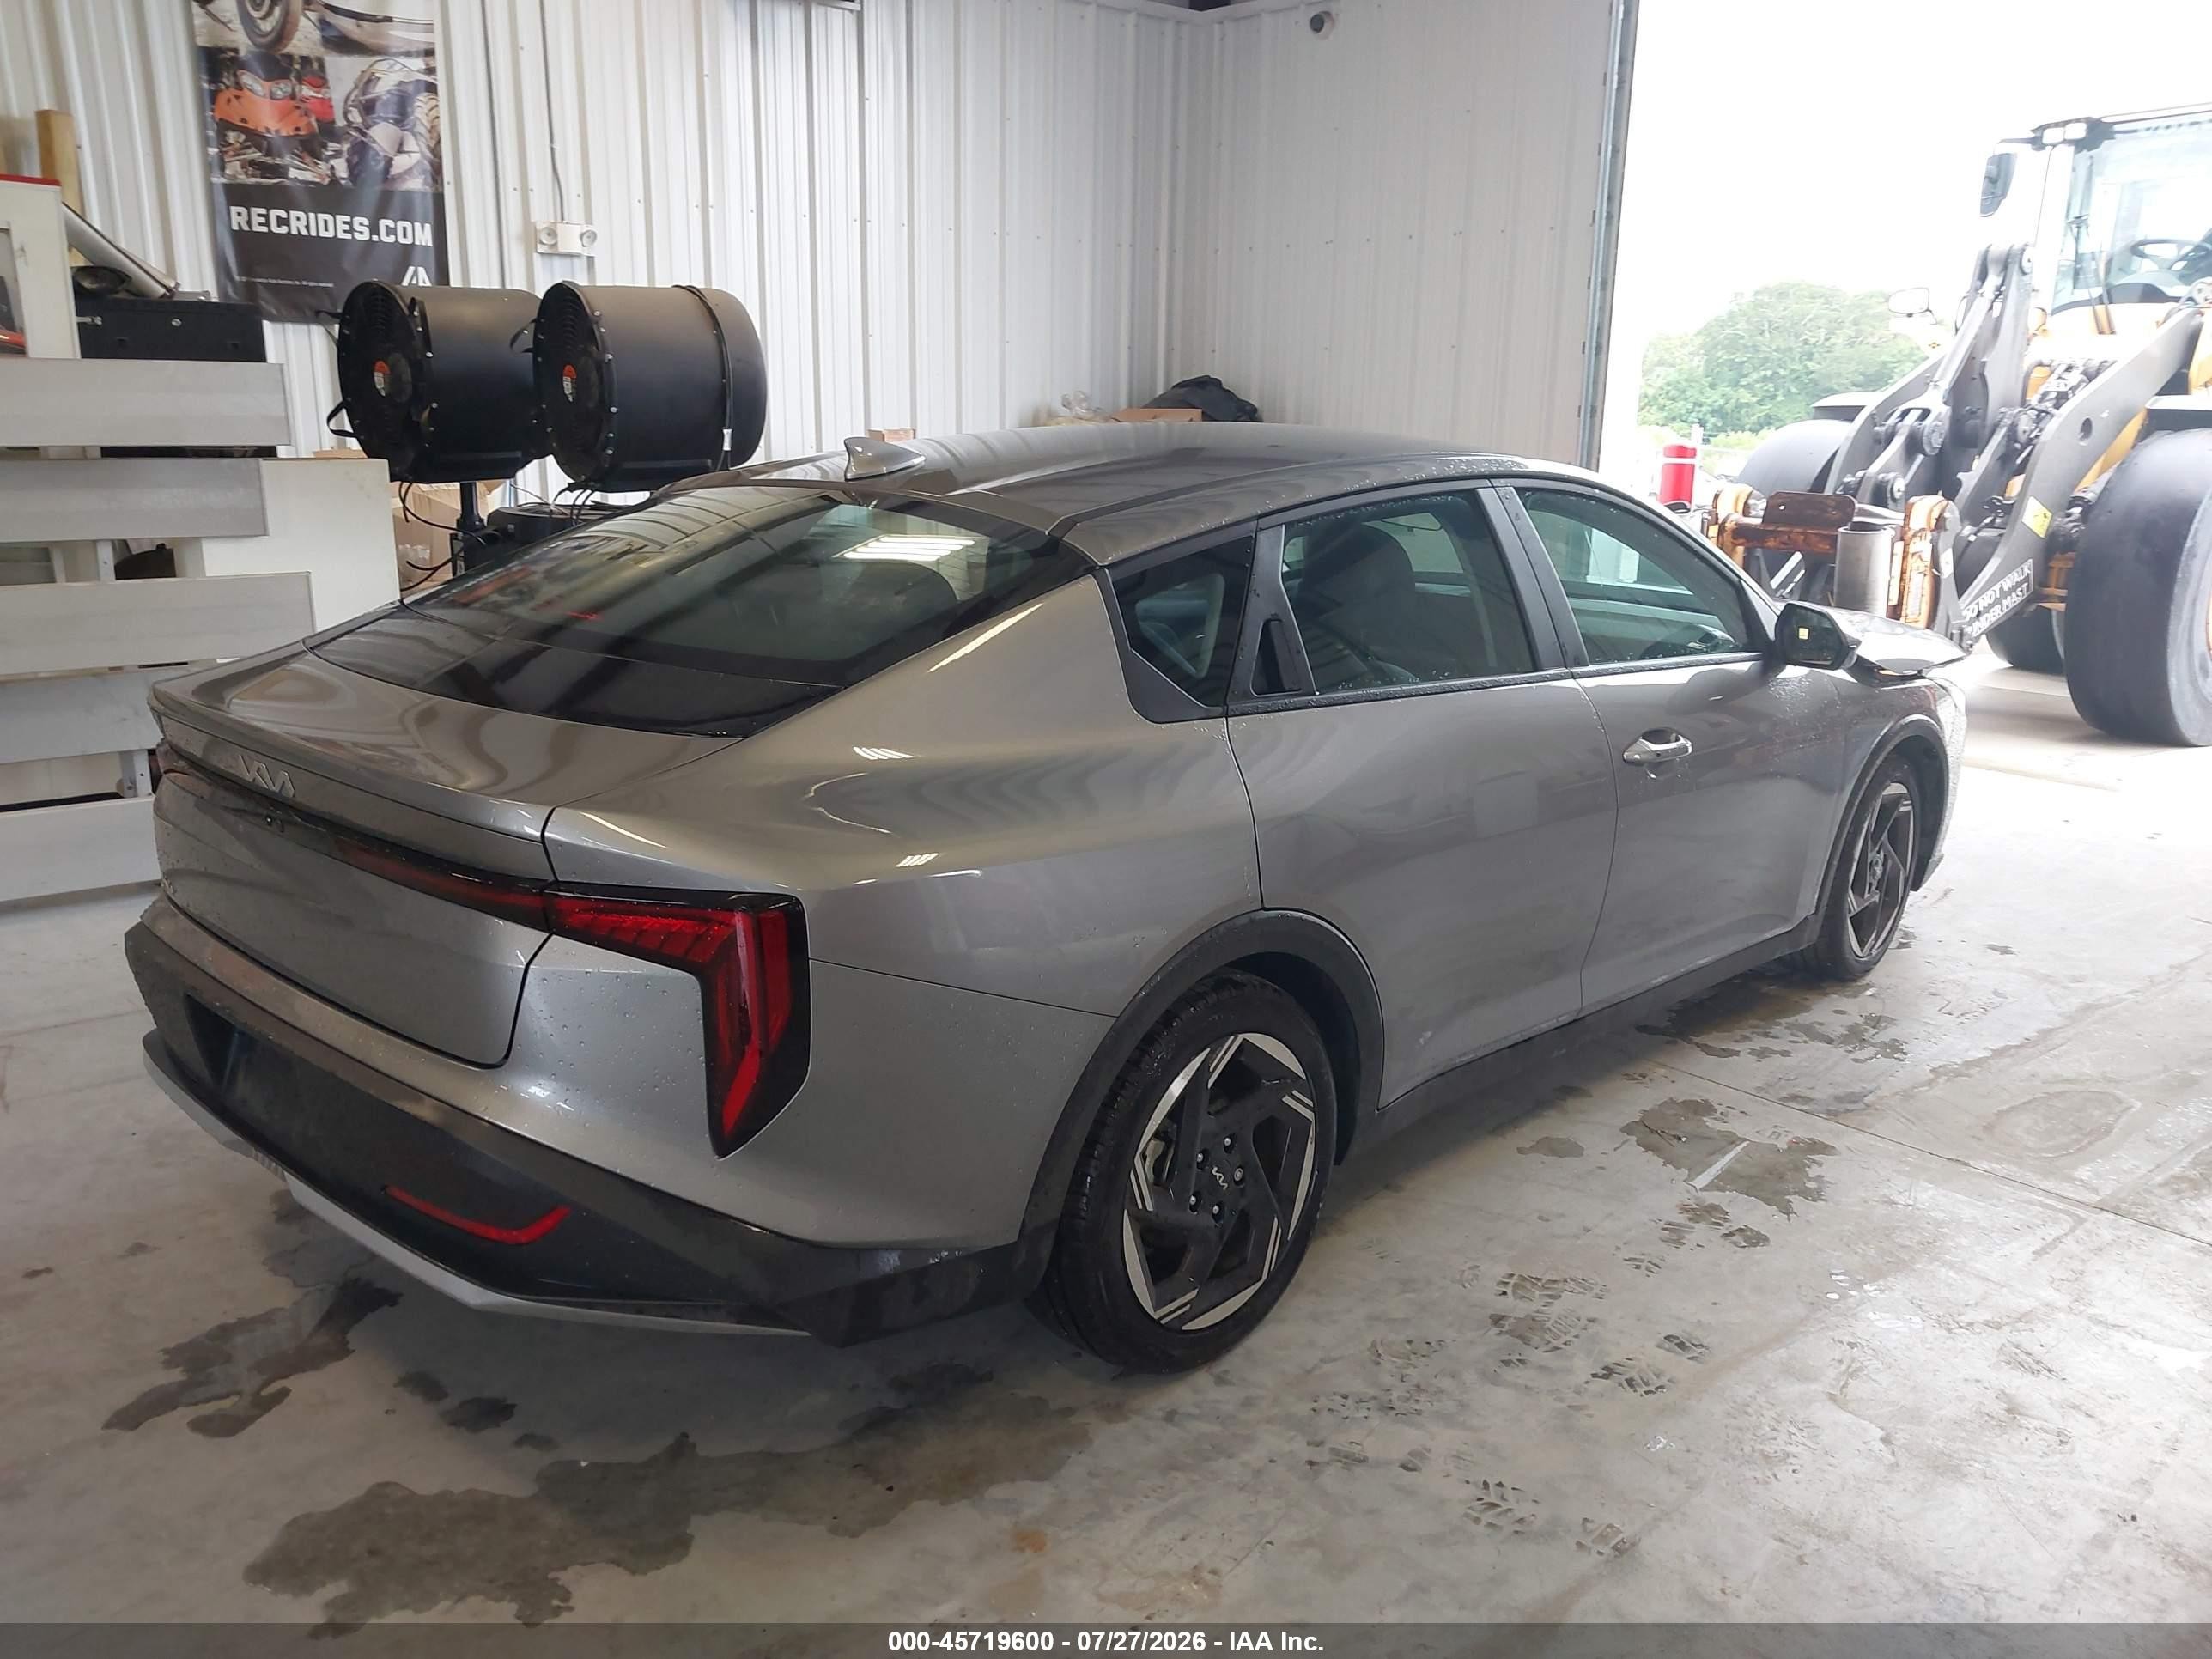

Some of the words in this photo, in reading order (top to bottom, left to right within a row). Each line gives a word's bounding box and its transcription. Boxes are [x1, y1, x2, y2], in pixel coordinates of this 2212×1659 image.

[229, 205, 434, 246] RECRIDES.COM
[1978, 583, 2002, 611] NOT
[2001, 563, 2031, 592] WALK
[2002, 582, 2029, 611] MAST
